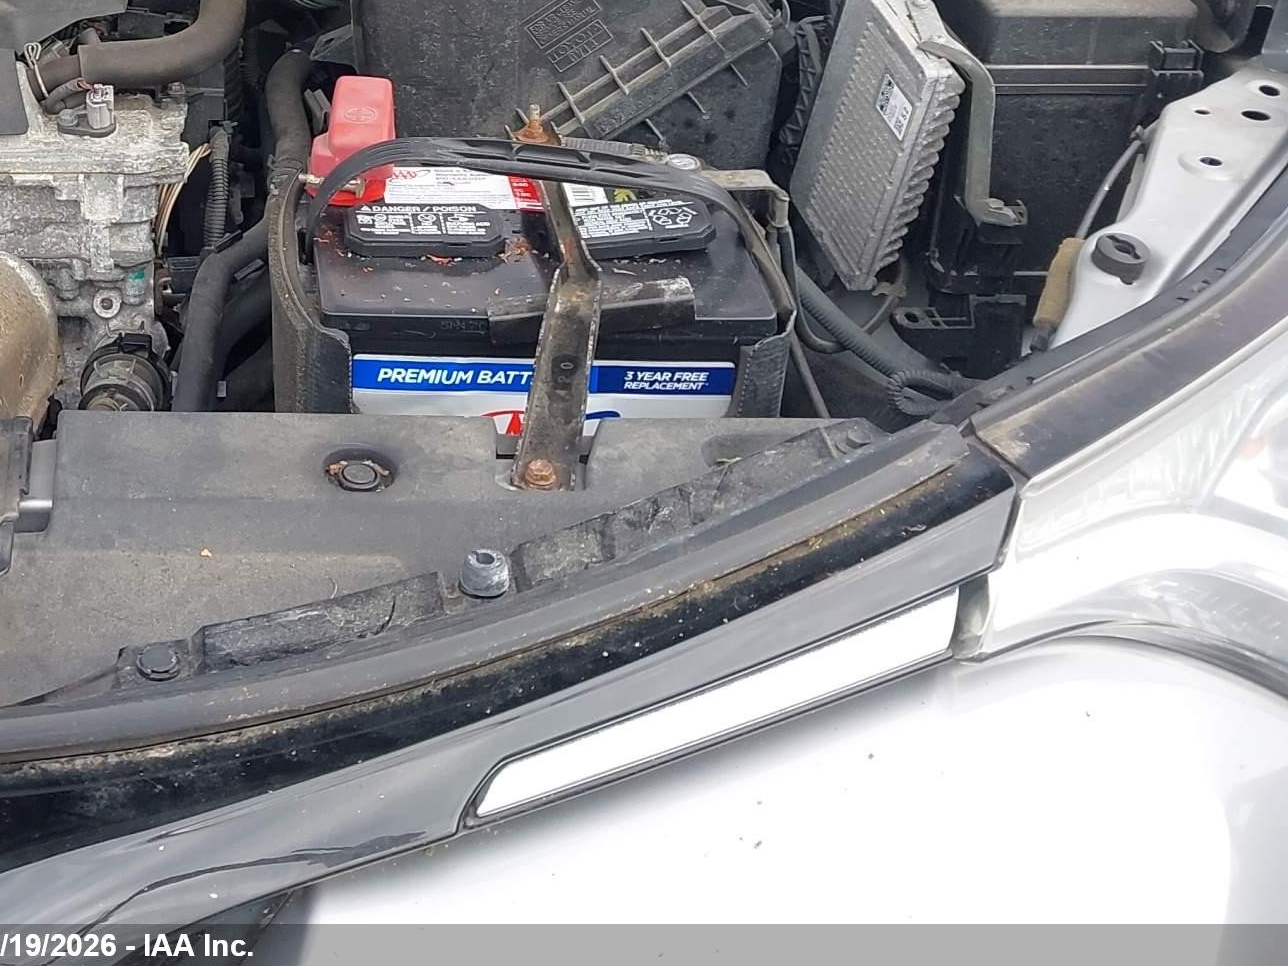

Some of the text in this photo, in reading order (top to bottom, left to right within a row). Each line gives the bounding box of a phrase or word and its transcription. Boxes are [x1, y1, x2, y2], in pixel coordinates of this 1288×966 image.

[377, 367, 536, 385] PREMIUM BATT
[623, 370, 710, 382] 3 YEAR FREE
